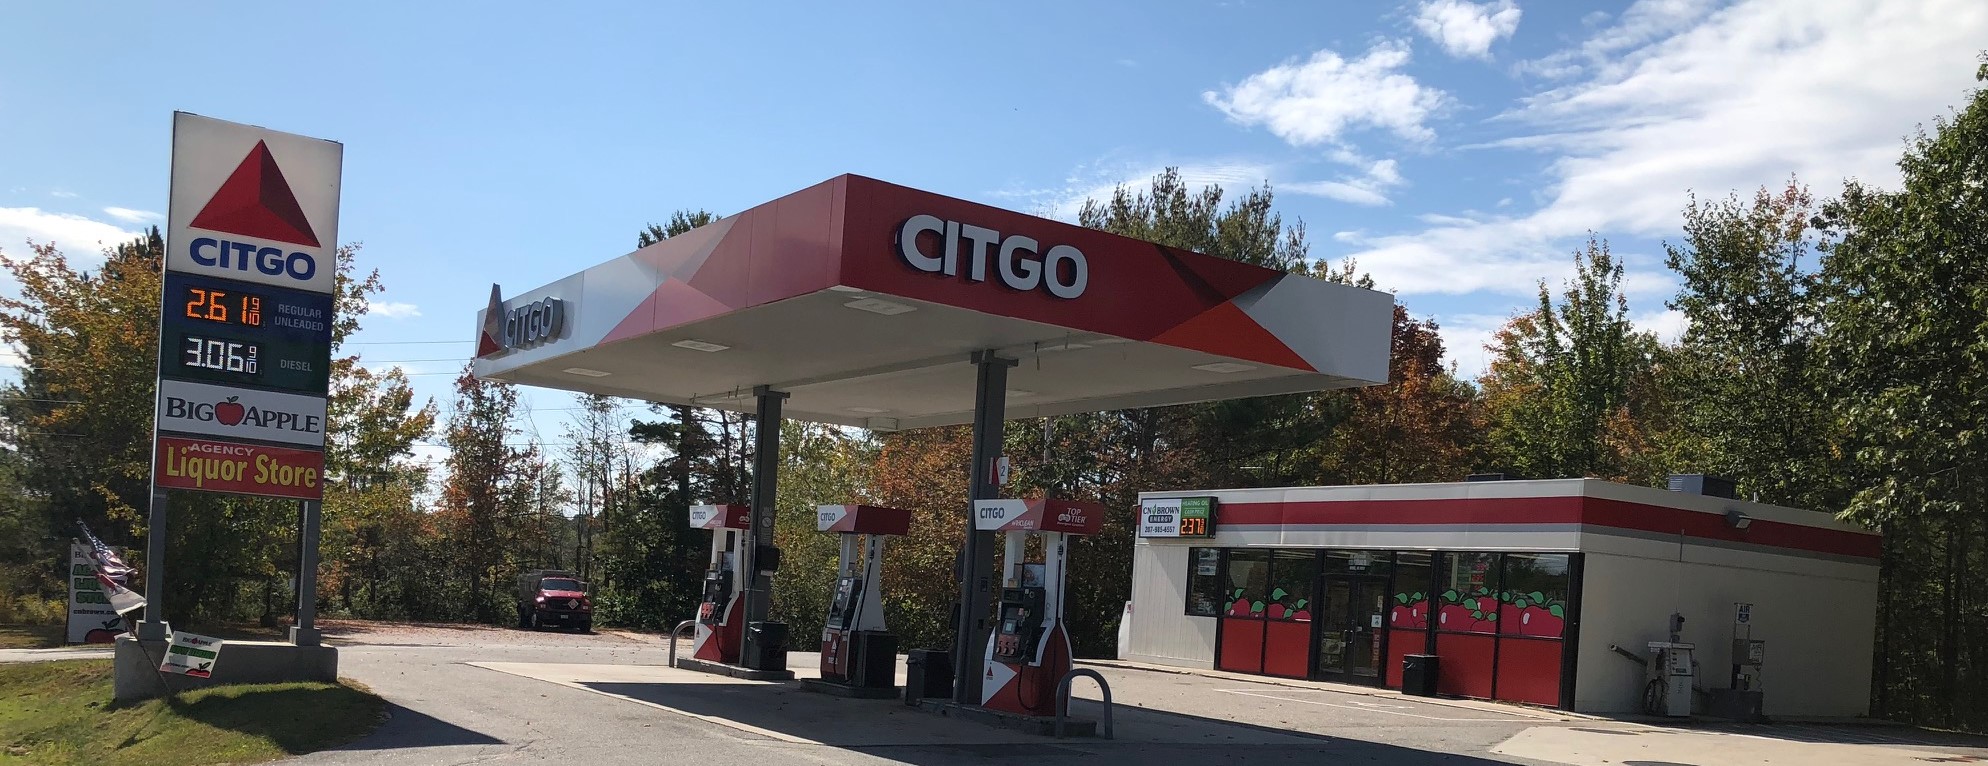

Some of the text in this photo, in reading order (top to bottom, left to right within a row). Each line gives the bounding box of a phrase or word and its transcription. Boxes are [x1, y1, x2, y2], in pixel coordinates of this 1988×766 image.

[189, 237, 316, 281] CITGO
[901, 214, 1089, 299] CITGO
[186, 288, 248, 325] 2.61
[278, 303, 322, 319] REGULAR
[274, 316, 324, 332] UNLEADED
[504, 296, 560, 349] CITGO
[186, 337, 244, 373] 3.06
[280, 359, 313, 372] DIESEL
[166, 396, 320, 434] BIG APPLE
[189, 443, 255, 457] AGENCY
[166, 446, 318, 489] Liquor Store
[1000, 465, 1006, 477] 2
[692, 511, 706, 520] CITGO
[820, 512, 836, 522] CITGO
[980, 507, 1005, 519] CITGO
[1067, 507, 1082, 516] TOP
[1156, 506, 1180, 515] BROWN
[1071, 515, 1086, 524] TIER
[1149, 515, 1172, 523] ENERGY
[1739, 605, 1750, 613] AIR
